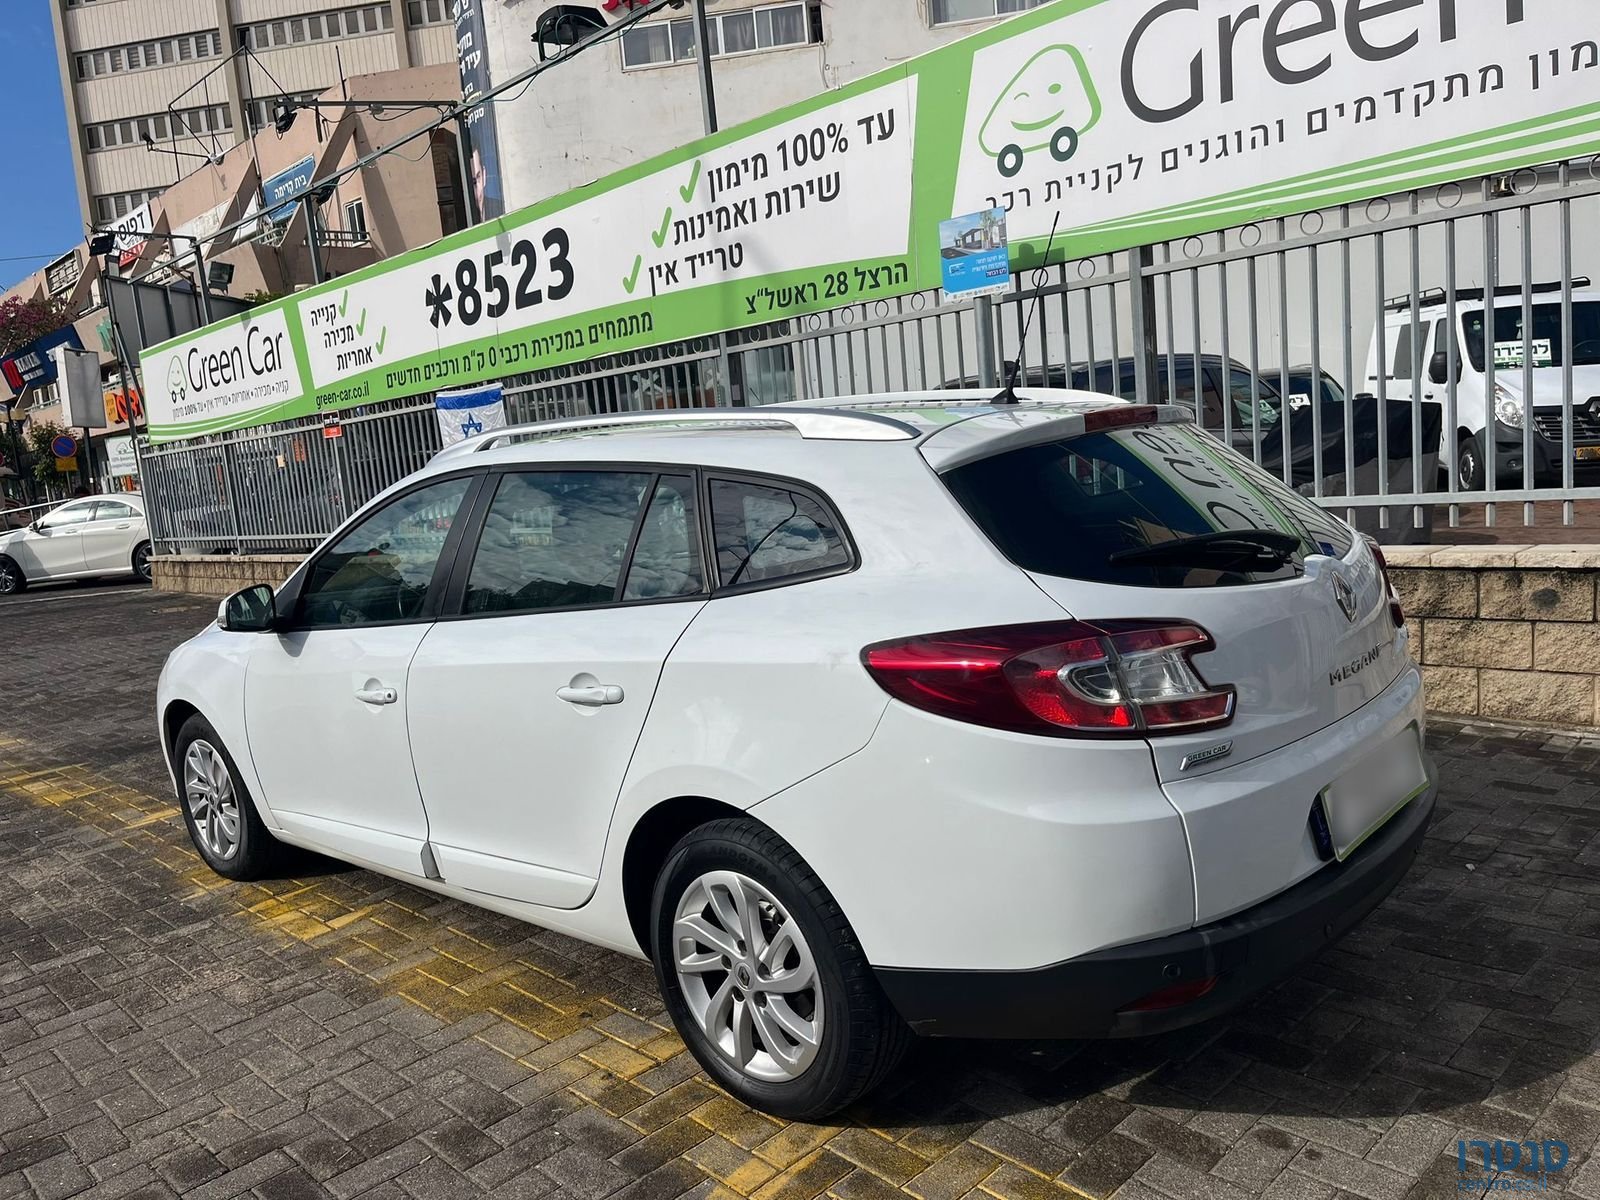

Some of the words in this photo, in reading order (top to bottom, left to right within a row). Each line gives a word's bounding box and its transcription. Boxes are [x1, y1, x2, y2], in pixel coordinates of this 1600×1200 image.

[1307, 63, 1504, 136] מתקדמים
[857, 108, 895, 145] עד
[777, 122, 849, 171] 100%
[1161, 119, 1284, 173] והוגנים
[294, 174, 307, 190] בית
[708, 153, 768, 203] מימון
[1044, 154, 1143, 202] לקניית
[765, 171, 841, 219] שירות
[118, 211, 144, 241] דפוס
[674, 197, 757, 245] ואמינות
[685, 242, 744, 279] טרייד
[648, 260, 678, 297] אין
[823, 271, 849, 299] 28
[854, 262, 908, 291] הרצל
[311, 303, 337, 326] קנייה
[588, 311, 653, 345] מתמחים
[324, 325, 354, 348] מכירה
[531, 328, 584, 358] במכירת
[187, 347, 245, 393] Green
[247, 326, 283, 376] Car
[337, 346, 373, 371] אחריות
[423, 358, 459, 380] ורכבים
[488, 346, 497, 367] 0
[500, 343, 528, 365] רכבי
[386, 367, 421, 388] חדשים
[184, 403, 198, 416] 100%
[315, 381, 370, 409] green-car.co.il
[1187, 749, 1211, 761] GREEN
[1213, 745, 1226, 754] CAR
